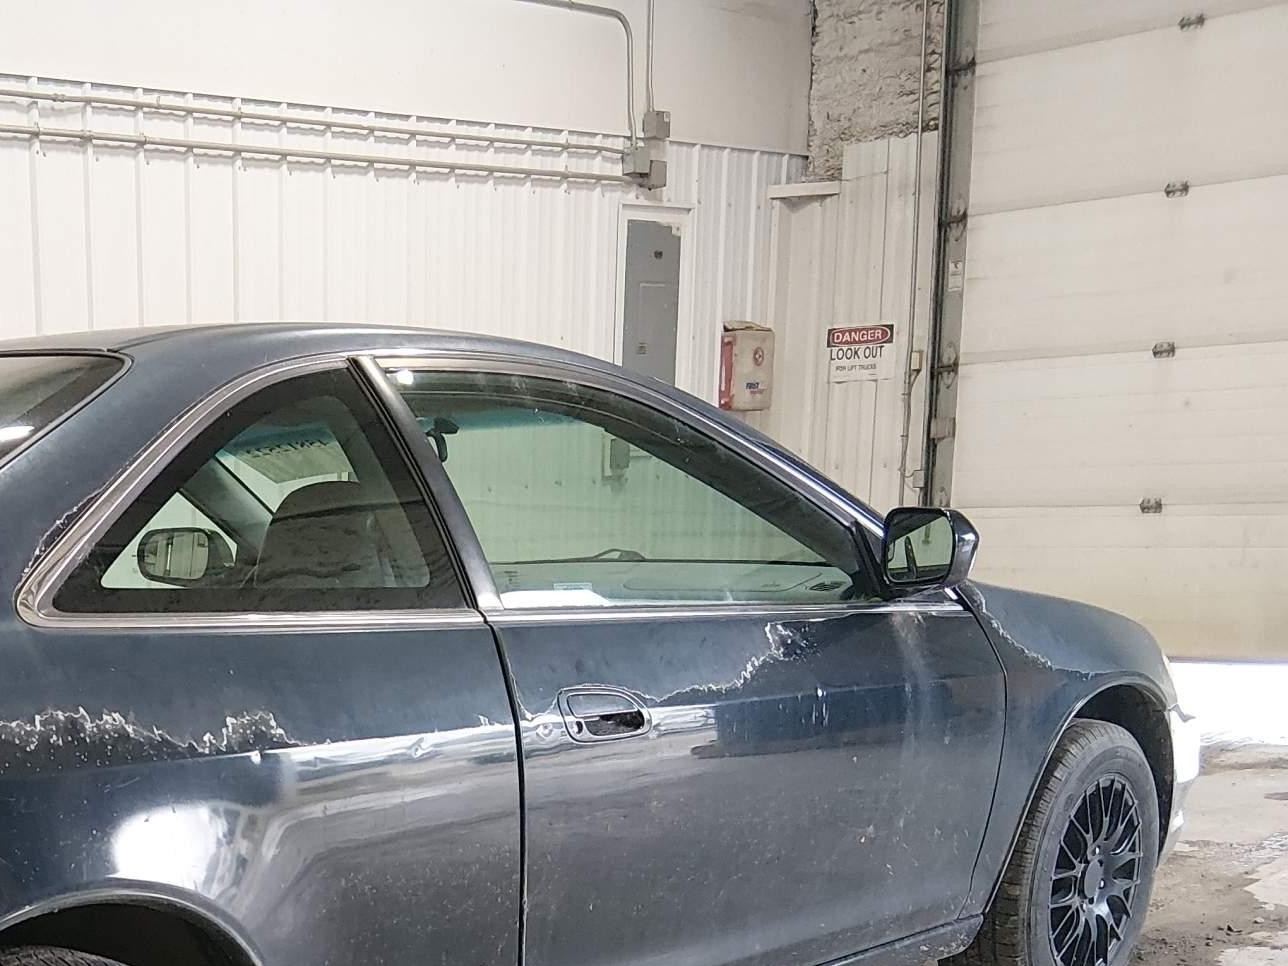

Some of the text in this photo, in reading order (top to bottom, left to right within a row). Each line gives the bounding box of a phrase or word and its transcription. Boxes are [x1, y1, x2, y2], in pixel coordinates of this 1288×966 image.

[833, 329, 882, 343] DANGER
[830, 345, 885, 361] LOOK OUT
